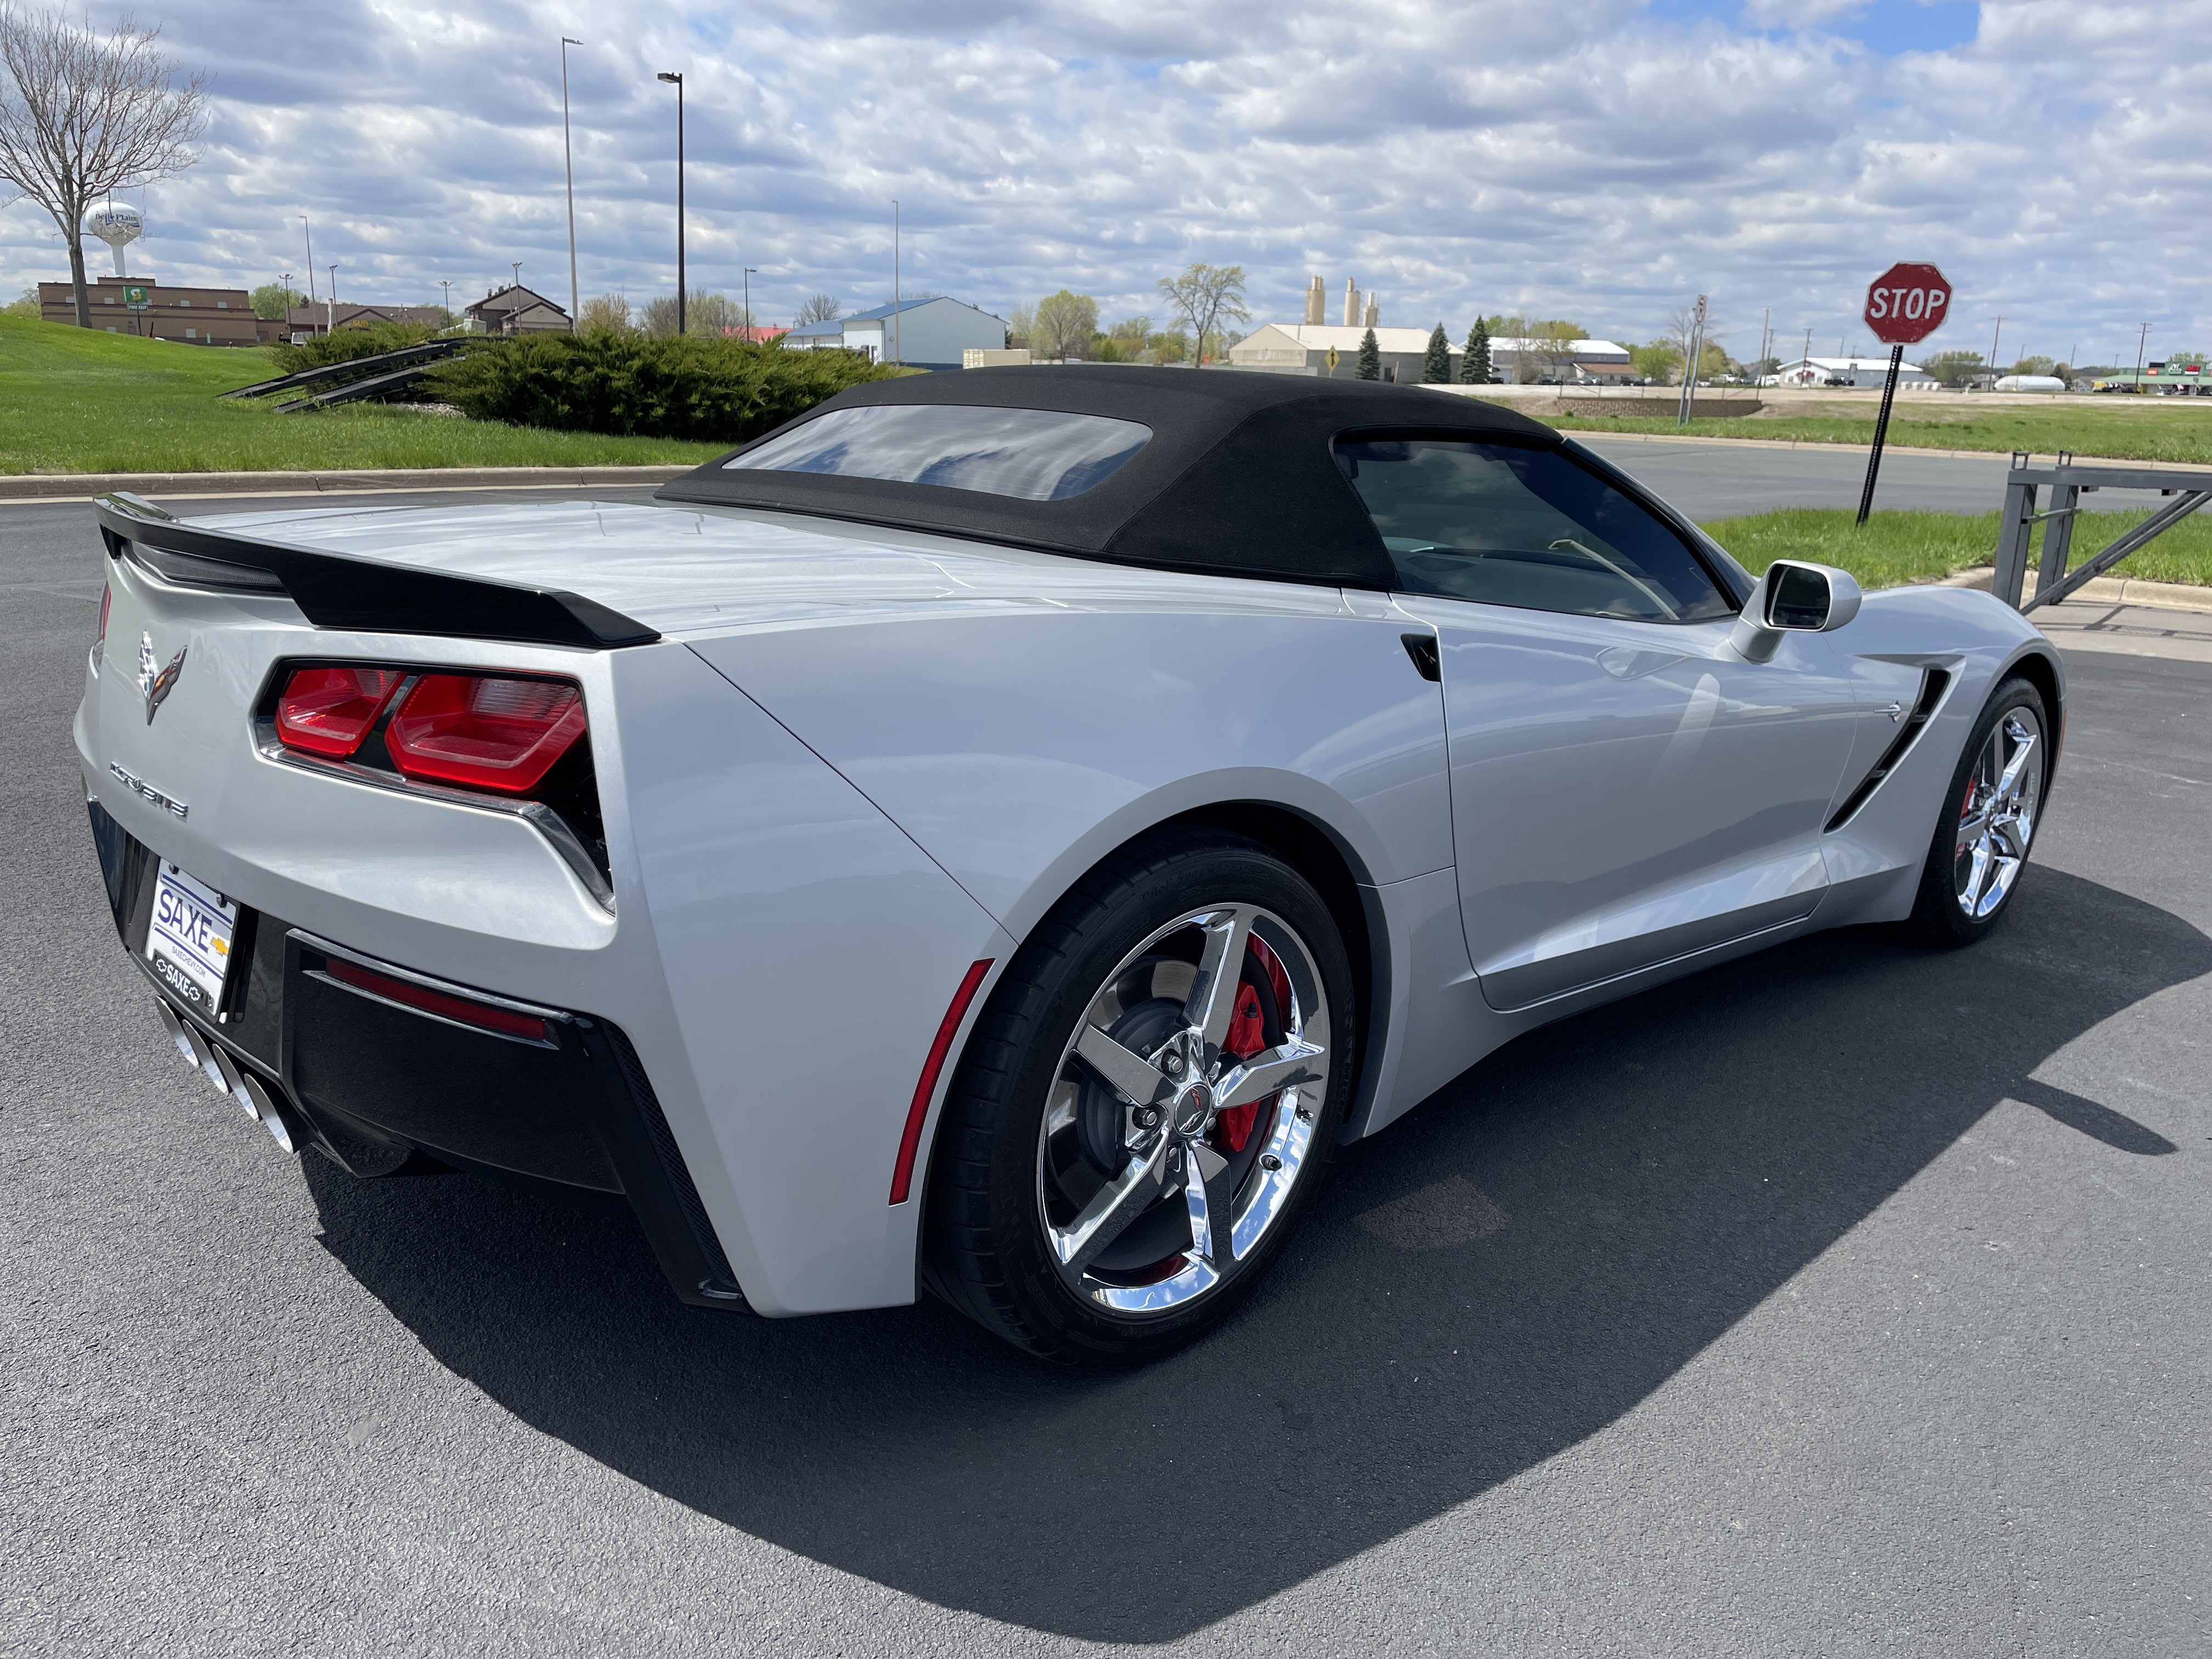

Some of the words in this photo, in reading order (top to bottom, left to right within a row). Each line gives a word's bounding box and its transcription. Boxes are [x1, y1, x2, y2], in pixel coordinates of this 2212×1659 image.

[1870, 287, 1946, 320] STOP
[110, 761, 188, 817] CORVETTE
[157, 888, 212, 954] SAXE
[172, 945, 206, 978] SAXECHEVY.COM
[165, 964, 191, 997] SAXE
